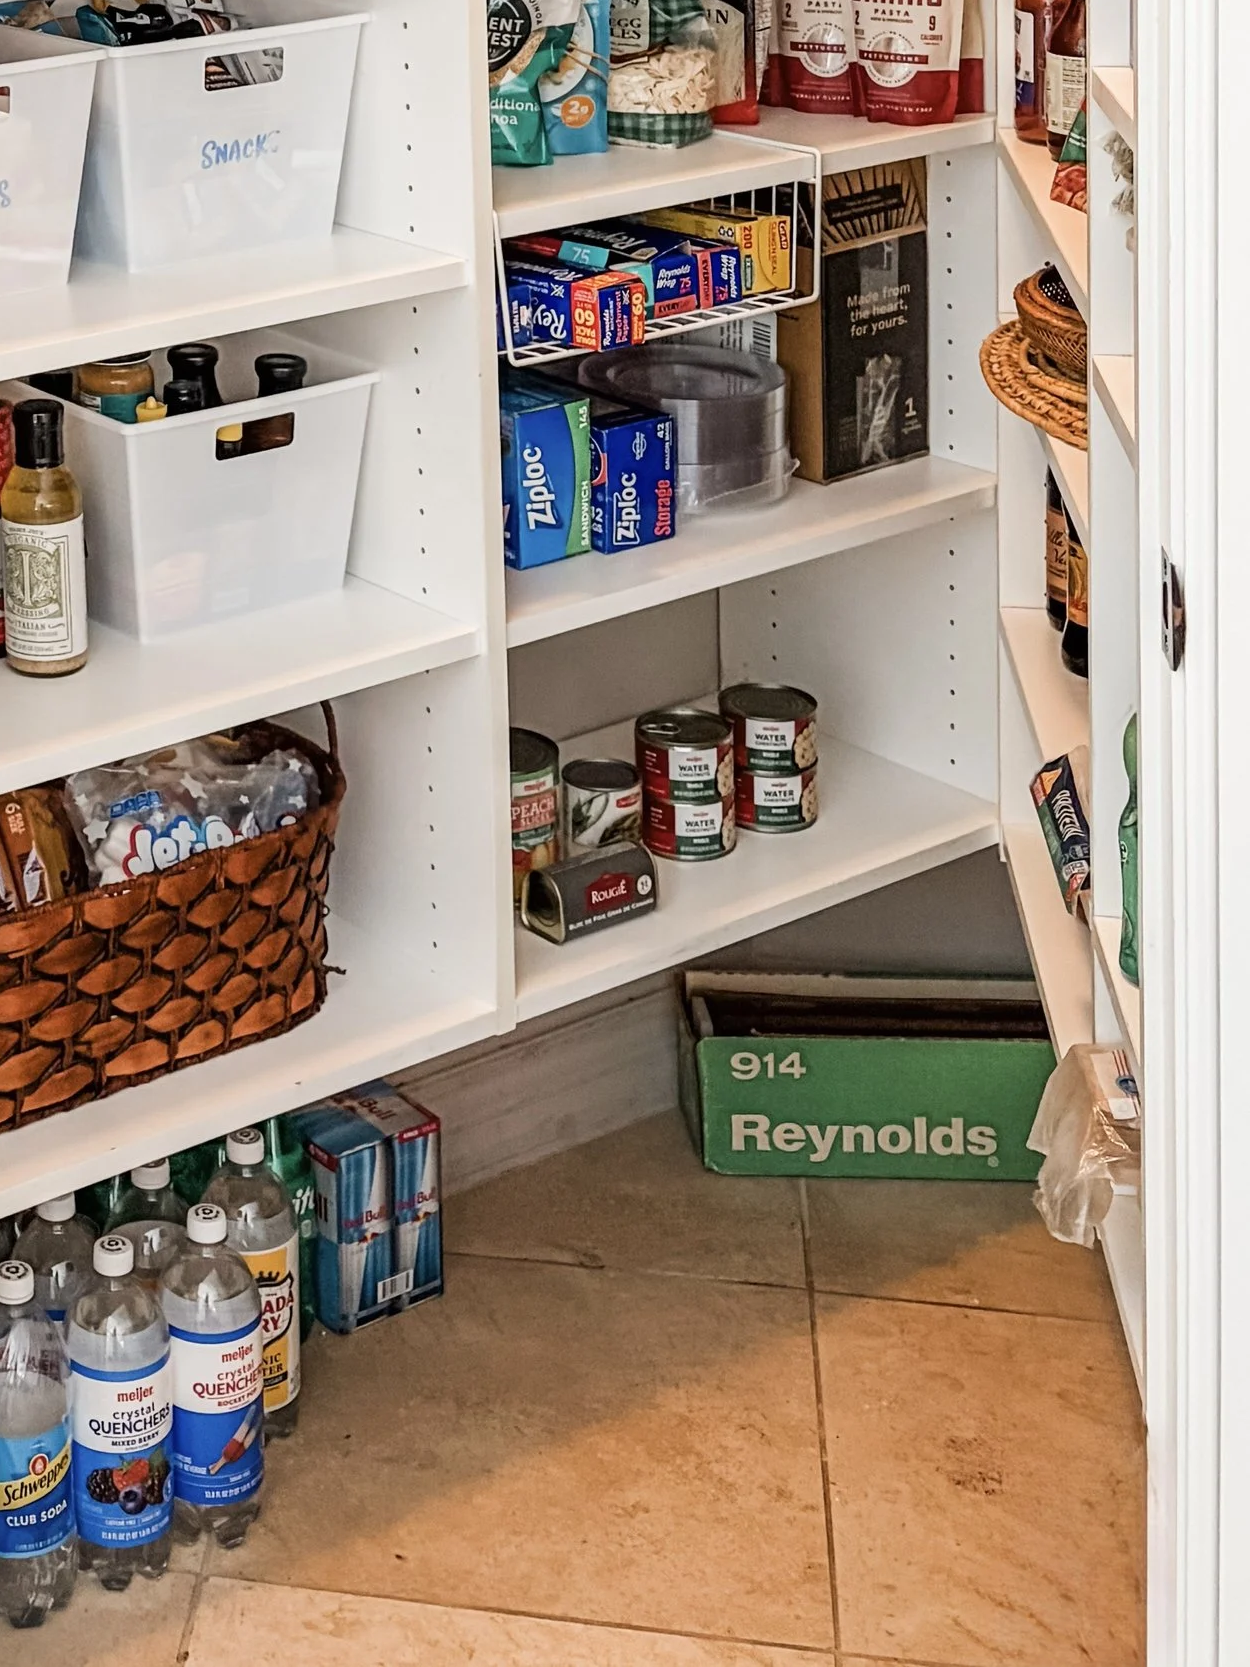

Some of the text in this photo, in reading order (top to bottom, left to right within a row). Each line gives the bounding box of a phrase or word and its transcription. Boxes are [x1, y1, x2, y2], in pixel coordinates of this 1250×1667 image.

[874, 8, 910, 18] PASTA
[929, 15, 936, 31] 9
[863, 52, 920, 63] FETTUCCINE
[743, 225, 753, 250] 200
[571, 247, 592, 265] 75
[720, 254, 729, 279] Wrap
[656, 275, 693, 292] Wrap 75
[657, 265, 692, 281] Reynolds
[701, 259, 710, 304] EVERYDAY
[728, 254, 738, 298] Reynolds
[632, 292, 643, 314] 60
[847, 282, 910, 309] Made from
[574, 308, 595, 325] 60
[603, 297, 614, 348] Reynolds
[850, 299, 908, 323] the heart,
[575, 327, 596, 338] PACK
[621, 314, 629, 345] Paper
[851, 314, 908, 338] for yours.
[578, 406, 588, 429] 145
[905, 397, 917, 418] 1
[657, 422, 665, 439] 42
[523, 446, 559, 530] Ziploc
[581, 480, 590, 546] SANDWICH
[616, 472, 637, 543] Ziploc
[654, 479, 673, 536] Storage
[15, 620, 47, 632] ITALIAN
[755, 733, 786, 743] WATER
[678, 763, 710, 774] WATER
[763, 789, 794, 799] WATER
[4, 802, 21, 815] 6
[512, 798, 554, 821] PEACH
[685, 818, 716, 829] WATER
[591, 880, 627, 905] ROUGIÉ
[730, 1051, 807, 1080] 914
[730, 1114, 998, 1163] Reynolds
[261, 1291, 294, 1318] ADA
[221, 1343, 254, 1363] meijer
[116, 1384, 154, 1403] meijer
[88, 1402, 171, 1436] QUENCHERS
[112, 1401, 156, 1421] crystal
[111, 1430, 160, 1448] MIXED BERRY
[2, 1451, 71, 1509] Schweppes
[6, 1498, 68, 1529] CLUB SODA
